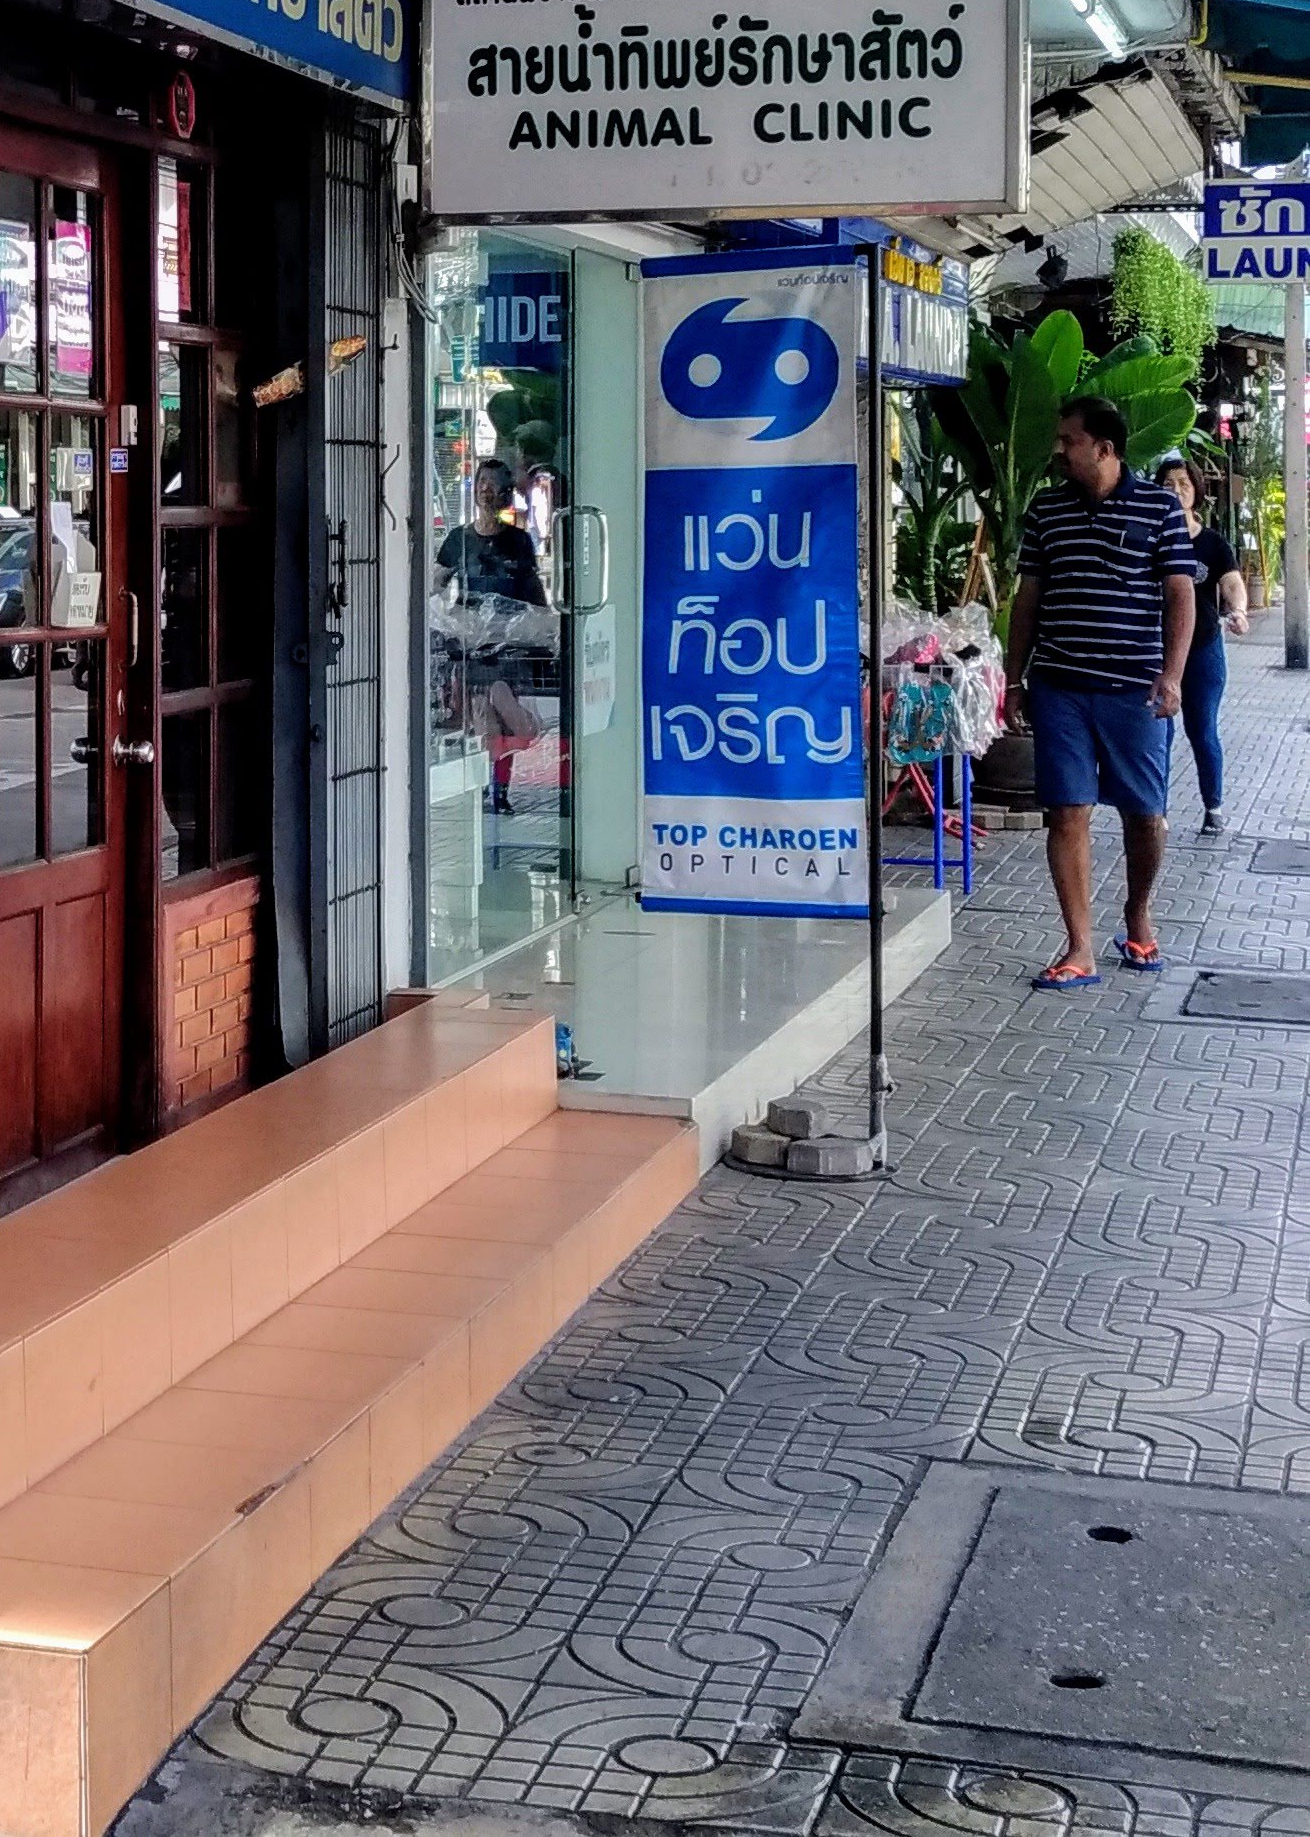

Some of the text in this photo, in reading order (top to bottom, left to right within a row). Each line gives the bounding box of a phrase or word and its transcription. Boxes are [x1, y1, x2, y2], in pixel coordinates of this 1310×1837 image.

[467, 3, 966, 97] สายน้ำทิพย์รักษาสัตว์
[508, 96, 932, 150] ANIMAL CLINIC
[683, 488, 812, 572] แว่น
[667, 595, 826, 676] ท็อป
[650, 692, 853, 765] เจริญ
[651, 822, 858, 851] TOP CHAROEN
[659, 852, 851, 878] OPTICAL
